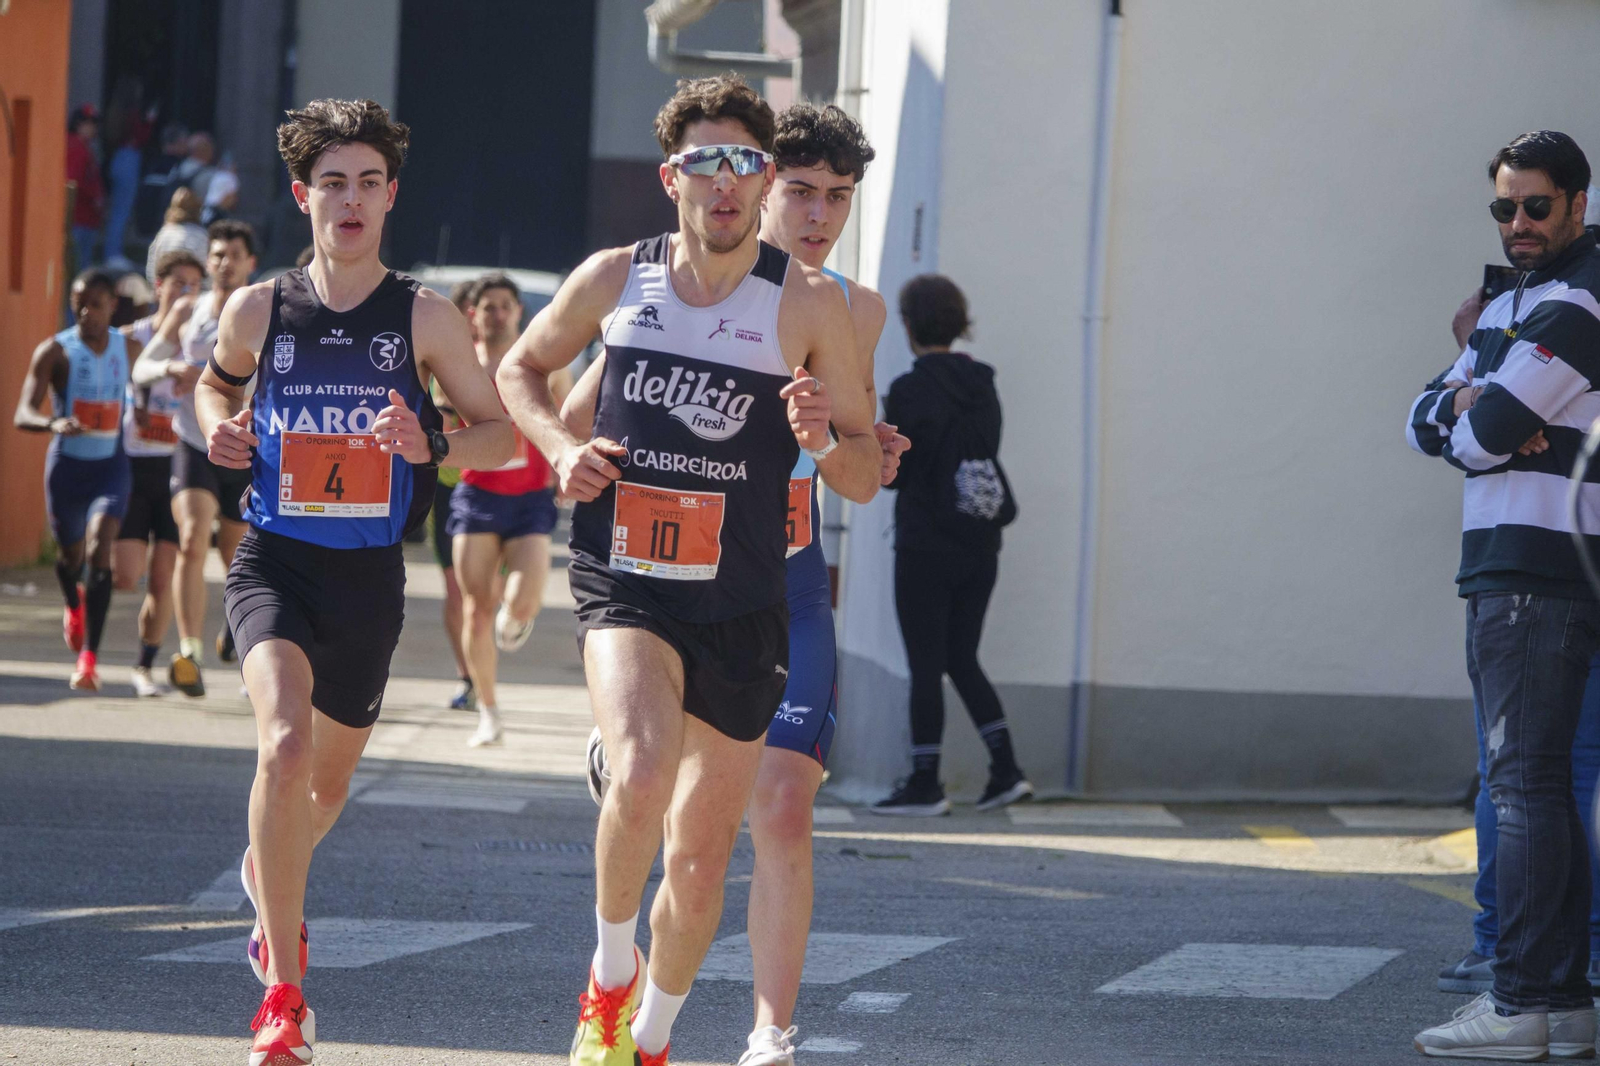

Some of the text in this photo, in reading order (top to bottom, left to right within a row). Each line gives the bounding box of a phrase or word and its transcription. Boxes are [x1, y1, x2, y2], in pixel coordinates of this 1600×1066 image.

[320, 336, 353, 345] amura
[735, 332, 763, 343] DELIKIA
[282, 384, 386, 397] CLUB ATLETISMO
[623, 360, 755, 420] delikia
[268, 399, 376, 435] NARÓ
[691, 412, 726, 431] fresh
[313, 437, 347, 446] PORRIÑO
[324, 453, 347, 461] ANXO
[324, 462, 345, 501] 4
[645, 491, 679, 503] PORRIÑO
[649, 508, 685, 521] INCUTTI
[650, 519, 680, 561] 10
[619, 559, 635, 568] LASAL
